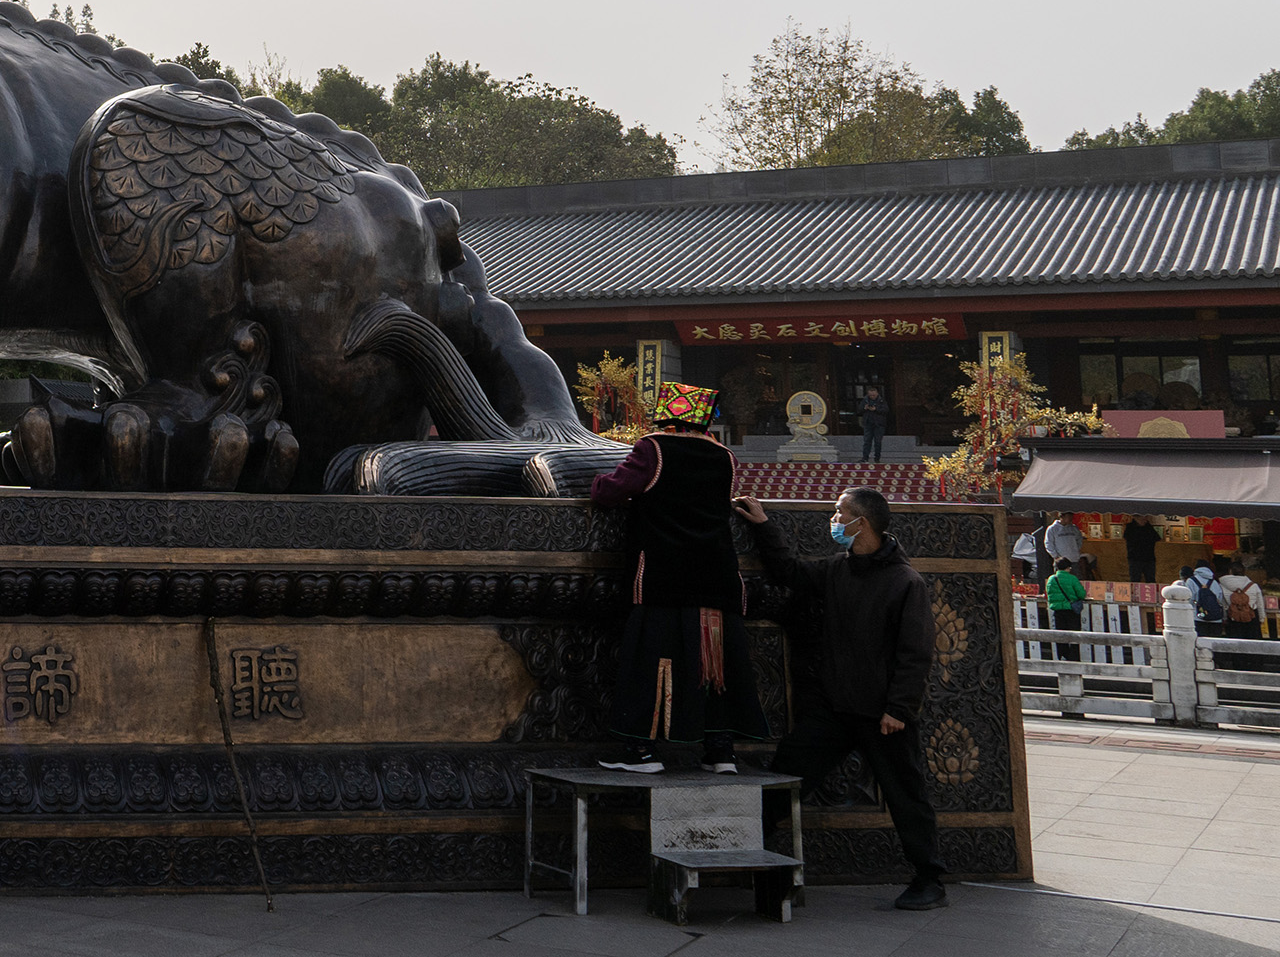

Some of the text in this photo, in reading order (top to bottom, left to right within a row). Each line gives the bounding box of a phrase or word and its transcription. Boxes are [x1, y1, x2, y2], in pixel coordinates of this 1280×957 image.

[691, 317, 950, 341] 大愿灵石文创博物馆
